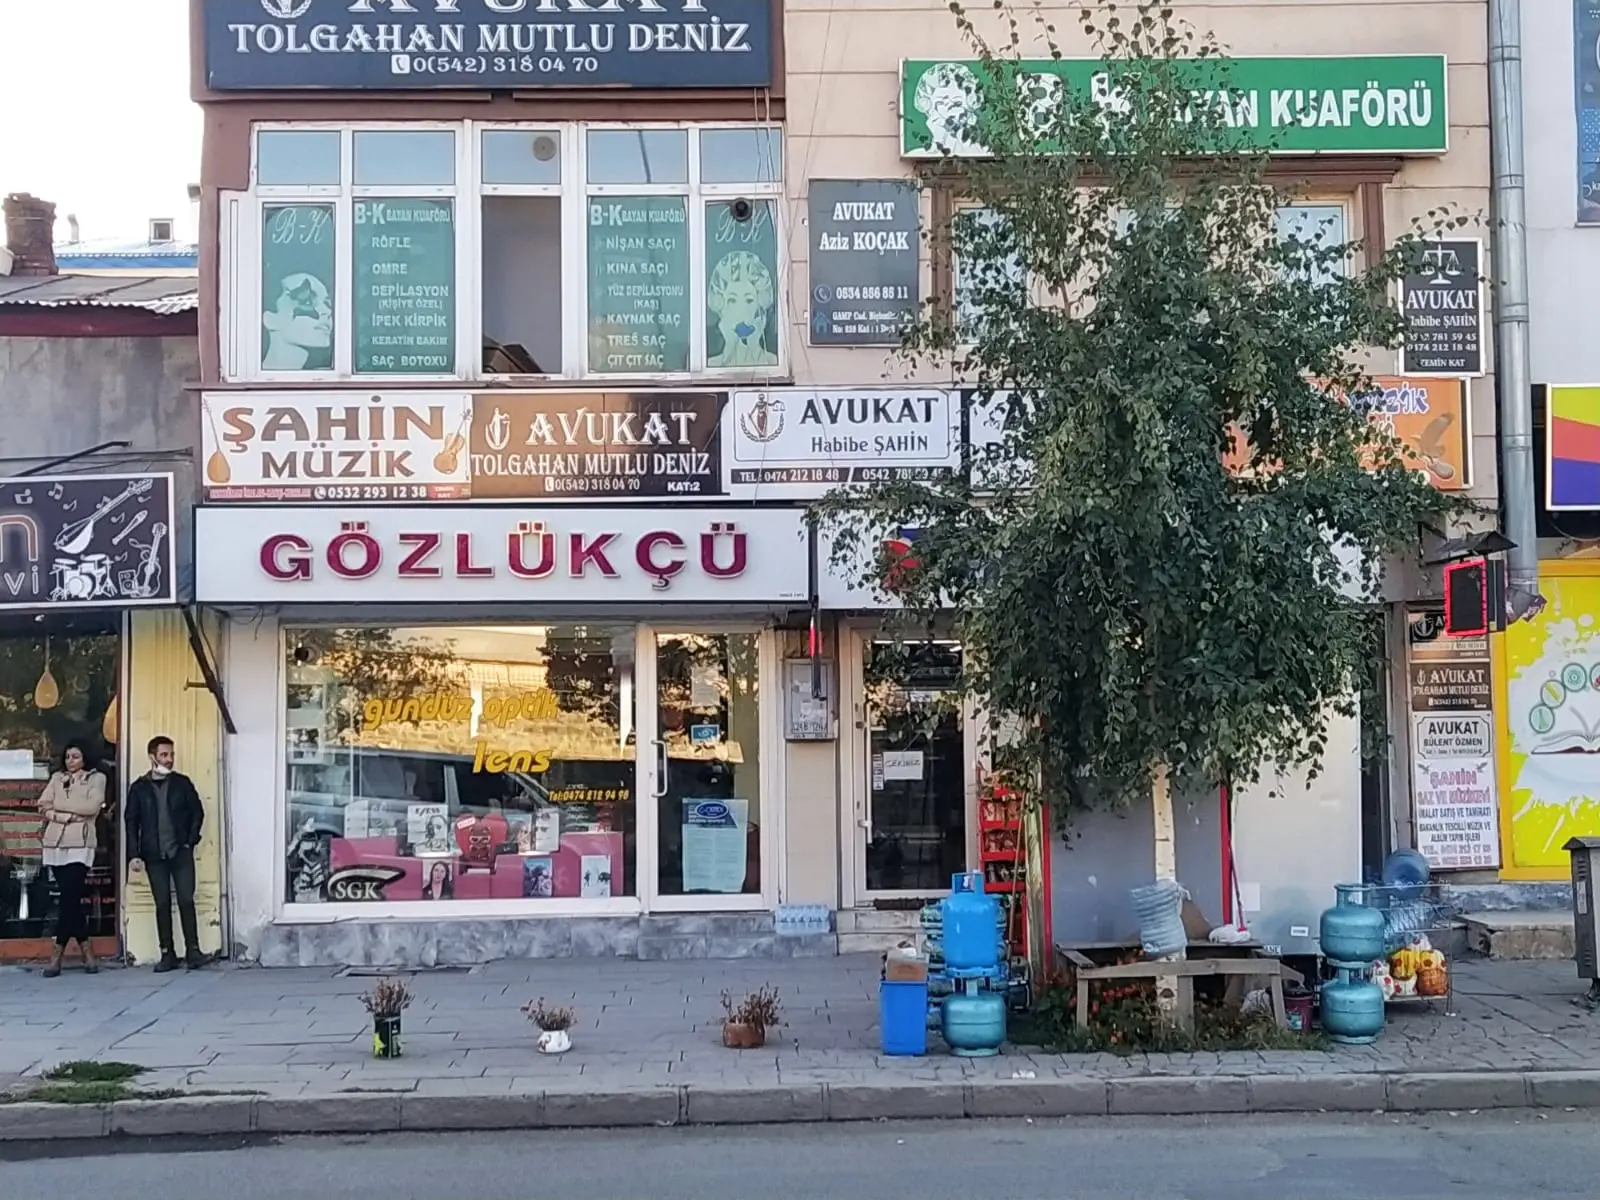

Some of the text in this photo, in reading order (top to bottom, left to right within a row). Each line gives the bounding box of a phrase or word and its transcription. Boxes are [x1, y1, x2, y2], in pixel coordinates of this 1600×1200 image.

[229, 15, 752, 53] TOLGAHAN MUTLU DENİZ
[412, 55, 599, 74] 0(542) 318 04 70
[1270, 81, 1433, 128] KUAFÖRÜ
[833, 202, 895, 220] AVUKAT
[606, 234, 676, 252] NİŞAN SAÇI
[819, 231, 909, 255] Aziz KOÇAK
[606, 263, 668, 277] KINA SAÇI
[371, 283, 449, 297] DEPİLASYON
[897, 287, 909, 299] 11
[1406, 289, 1476, 310] AVUKAT
[404, 312, 447, 327] KİRPİK
[606, 313, 681, 326] KAYNAK SAÇ
[642, 335, 667, 349] SAÇ
[371, 355, 395, 368] SAÇ
[1448, 359, 1466, 367] KAT
[799, 397, 940, 426] AVUKAT
[222, 395, 444, 453] ŞAHİN
[525, 407, 698, 446] AVUKAT
[811, 430, 929, 456] Habibe ŞAHİN
[261, 442, 415, 479] MÜZİK
[471, 447, 711, 476] TOLGAHAN MUTLU DENİZ
[591, 477, 611, 491] 318
[612, 477, 625, 491] 04
[628, 477, 641, 491] 70
[764, 472, 787, 482] 0474
[790, 469, 808, 481] 212
[811, 470, 823, 480] 18
[825, 469, 840, 481] 48
[862, 468, 890, 481] 0542
[327, 487, 360, 499] 0532
[364, 487, 387, 498] 293
[393, 486, 407, 498] 12
[410, 486, 427, 498] 38
[667, 481, 701, 492] KAT:2
[259, 520, 749, 592] GÖZLÜKÇÜ
[1430, 669, 1485, 684] AVUKAT
[482, 687, 560, 729] optik
[1428, 721, 1479, 736] AVUKAT
[1424, 736, 1482, 747] BÜLENT ÖZMEN
[472, 740, 552, 774] lens
[335, 881, 380, 899] SGK
